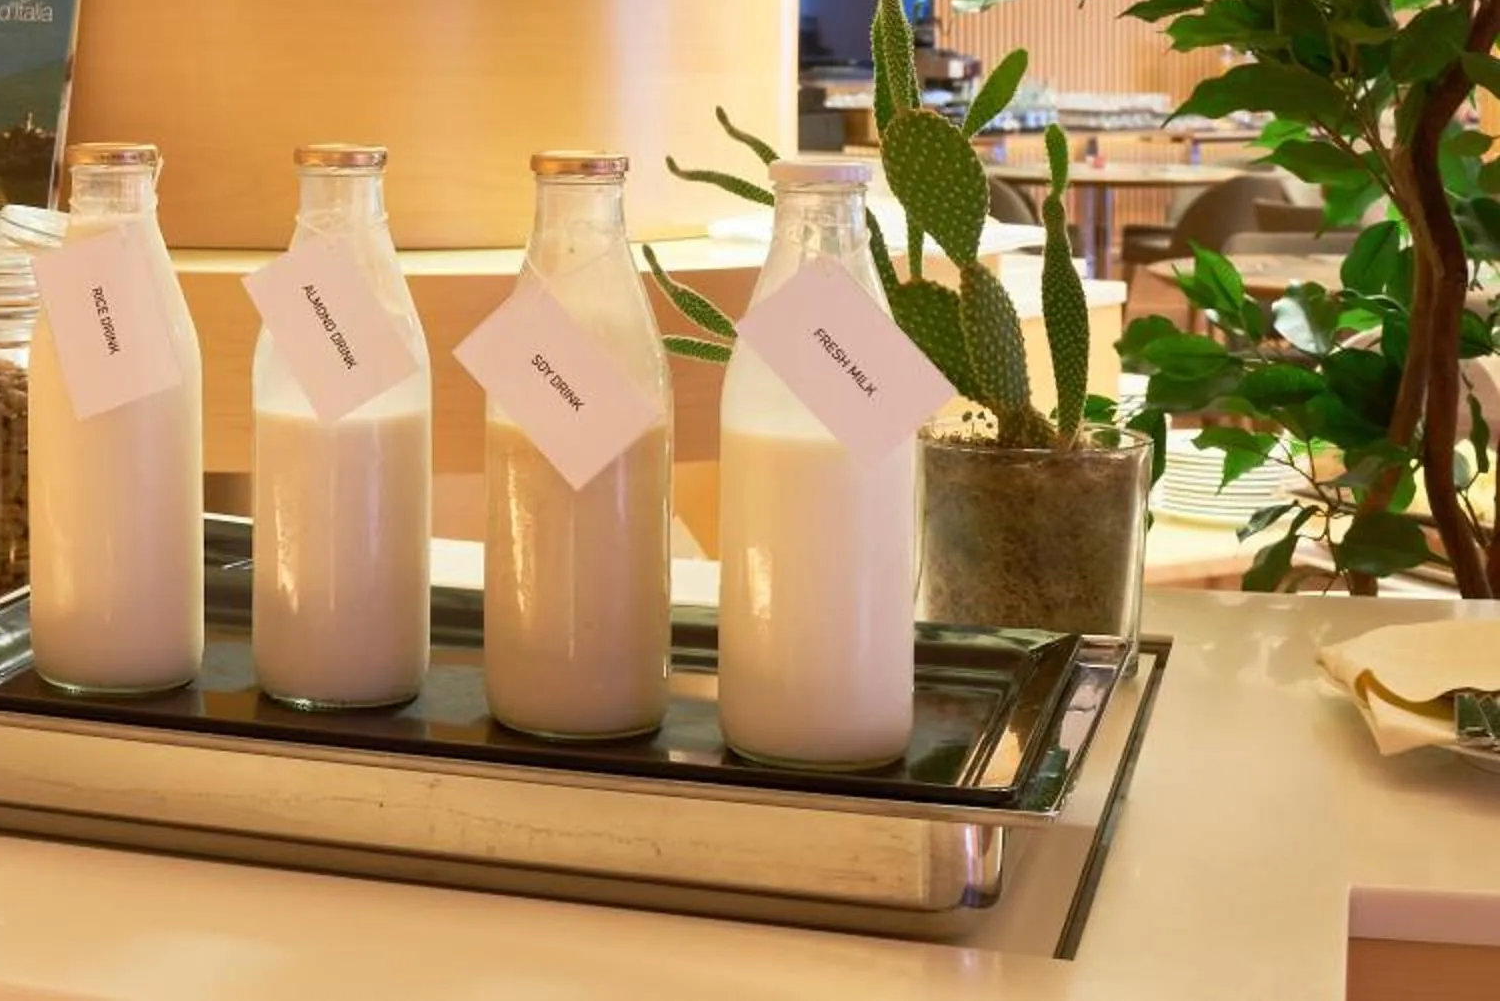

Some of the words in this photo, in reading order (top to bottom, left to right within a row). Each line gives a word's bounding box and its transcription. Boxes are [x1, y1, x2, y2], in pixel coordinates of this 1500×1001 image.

[92, 286, 109, 316] RICE
[301, 284, 338, 332] ALMOND
[329, 332, 358, 370] DRINK
[100, 316, 121, 355] DRINK
[813, 328, 851, 368] FRESH
[847, 365, 878, 398] MILK
[531, 353, 554, 375] SOY
[550, 374, 586, 411] DRINK
